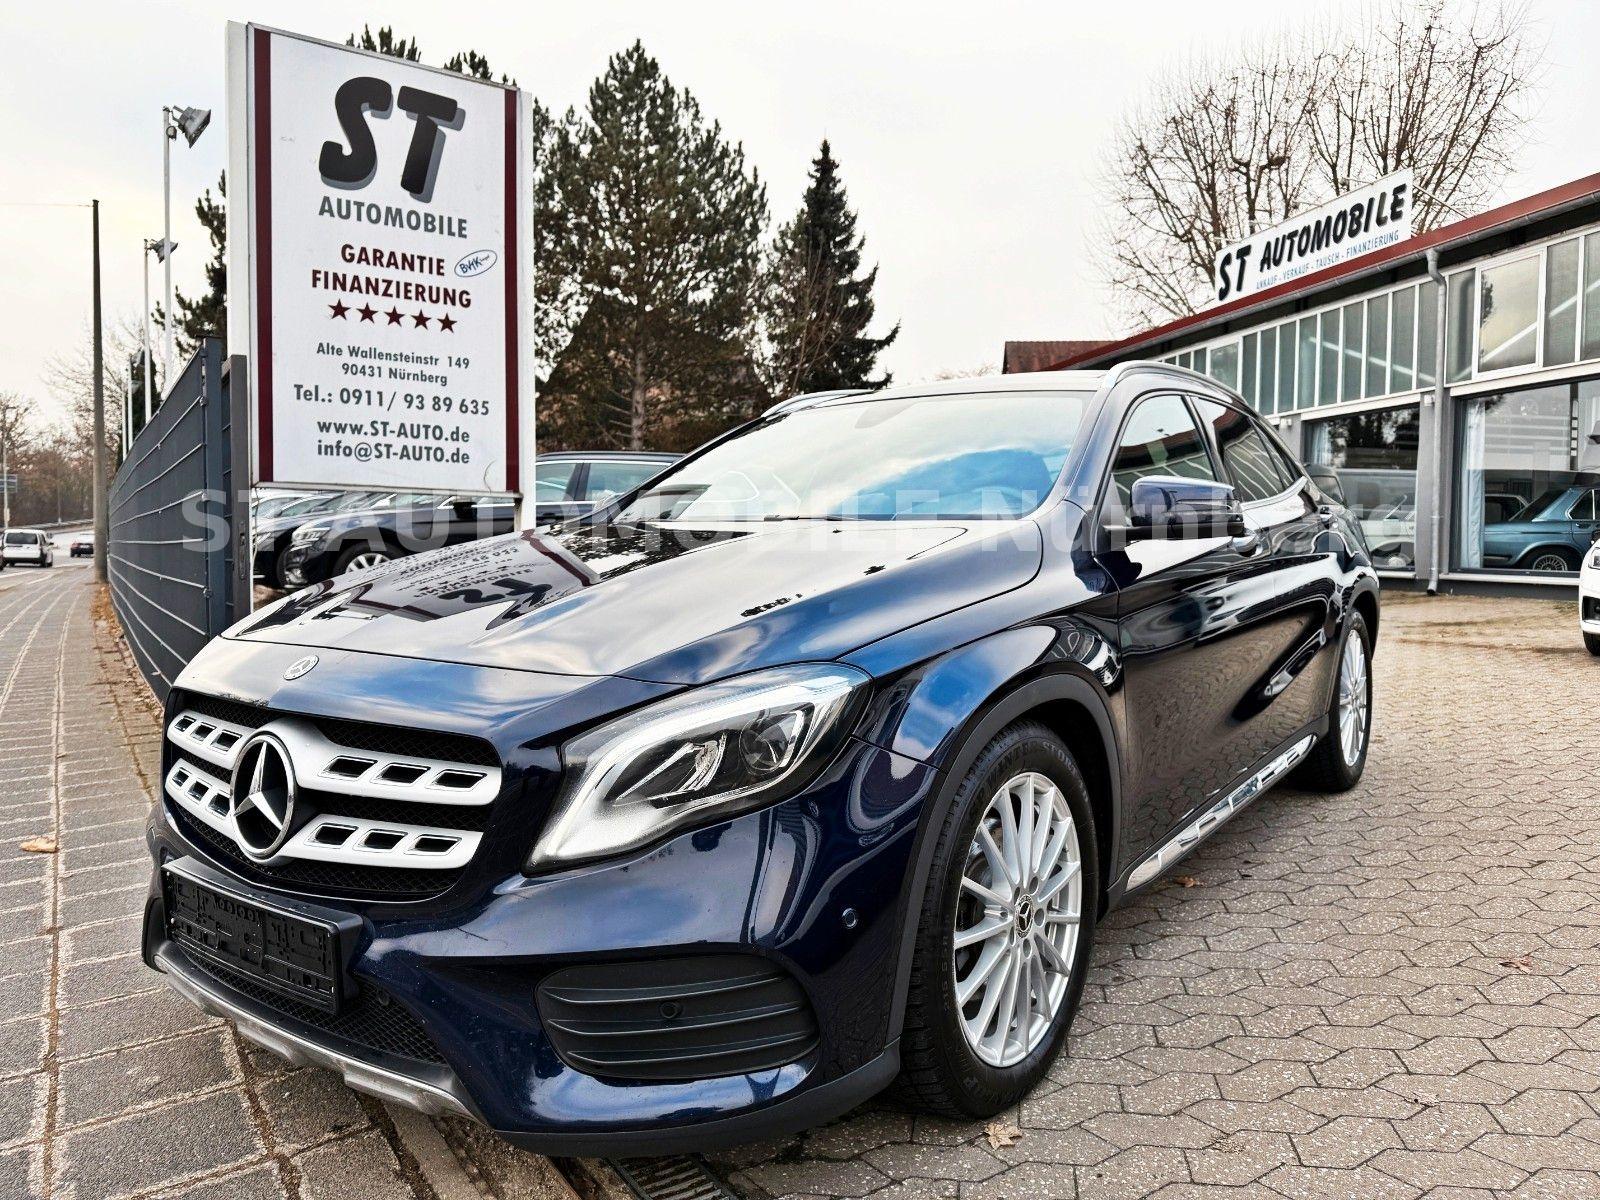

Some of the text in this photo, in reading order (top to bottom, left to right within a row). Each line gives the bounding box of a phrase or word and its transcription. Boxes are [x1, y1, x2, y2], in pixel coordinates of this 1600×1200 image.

[318, 76, 466, 204] ST
[318, 195, 468, 239] AUTOMOBILE
[1218, 183, 1407, 301] ST AUTOMOBILE
[1283, 263, 1310, 281] VERKAUF
[1316, 251, 1341, 269] TAUSCH
[1346, 229, 1400, 259] FINANZIERUNG
[340, 243, 446, 277] GARANTIE
[311, 269, 472, 308] FINANZIERUNG
[316, 342, 470, 369] Alte Wallensteinstr 149
[341, 363, 448, 387] 90431 Nürnberg
[293, 384, 490, 416] Tel.: 0911/ 93 89 635
[317, 420, 470, 443] www.ST-AUTO.de
[317, 440, 470, 464] info@ST-AUTO.de
